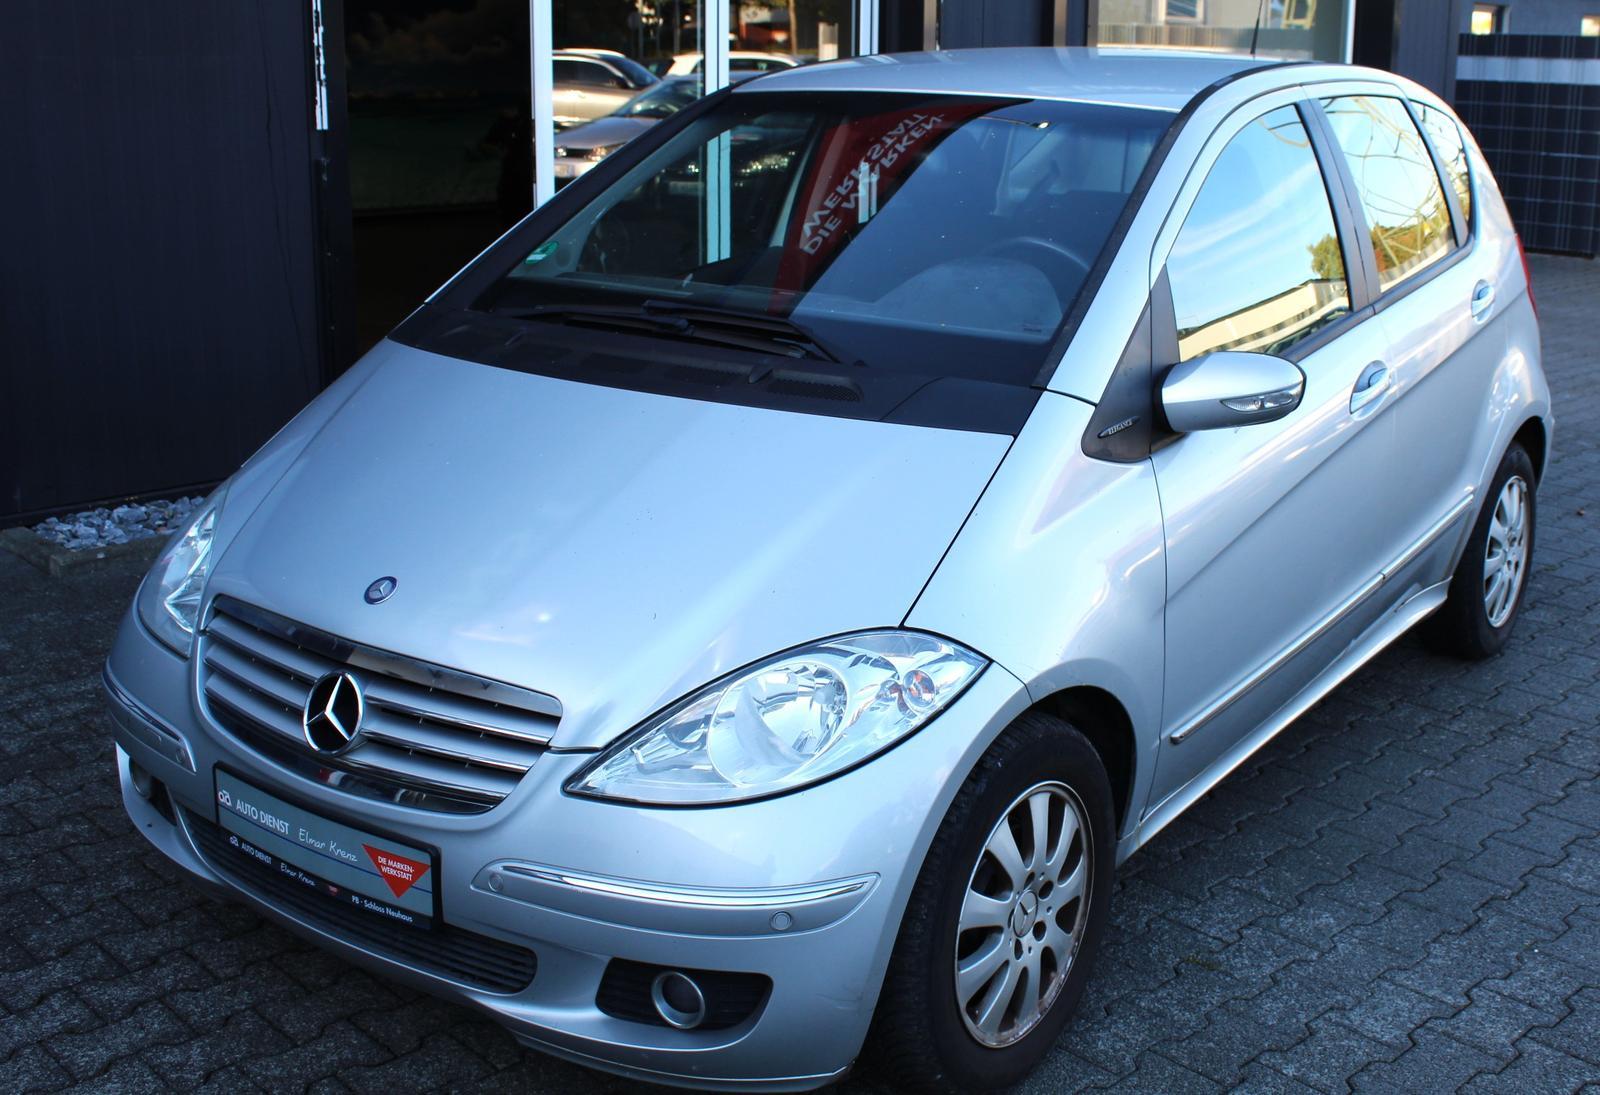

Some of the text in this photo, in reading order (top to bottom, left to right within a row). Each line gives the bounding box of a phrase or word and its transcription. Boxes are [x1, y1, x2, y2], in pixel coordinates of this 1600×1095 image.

[236, 800, 358, 862] AUTO DIENST Elmar Krenz
[241, 842, 254, 856] AUTO
[255, 850, 272, 865] DIENST
[280, 862, 296, 877] Elmar
[378, 856, 415, 873] DIE MARKEN-
[381, 865, 413, 881] WERKSTATT
[351, 895, 360, 904] PB
[364, 899, 385, 914] Schloss
[386, 907, 413, 922] Neuhaus
